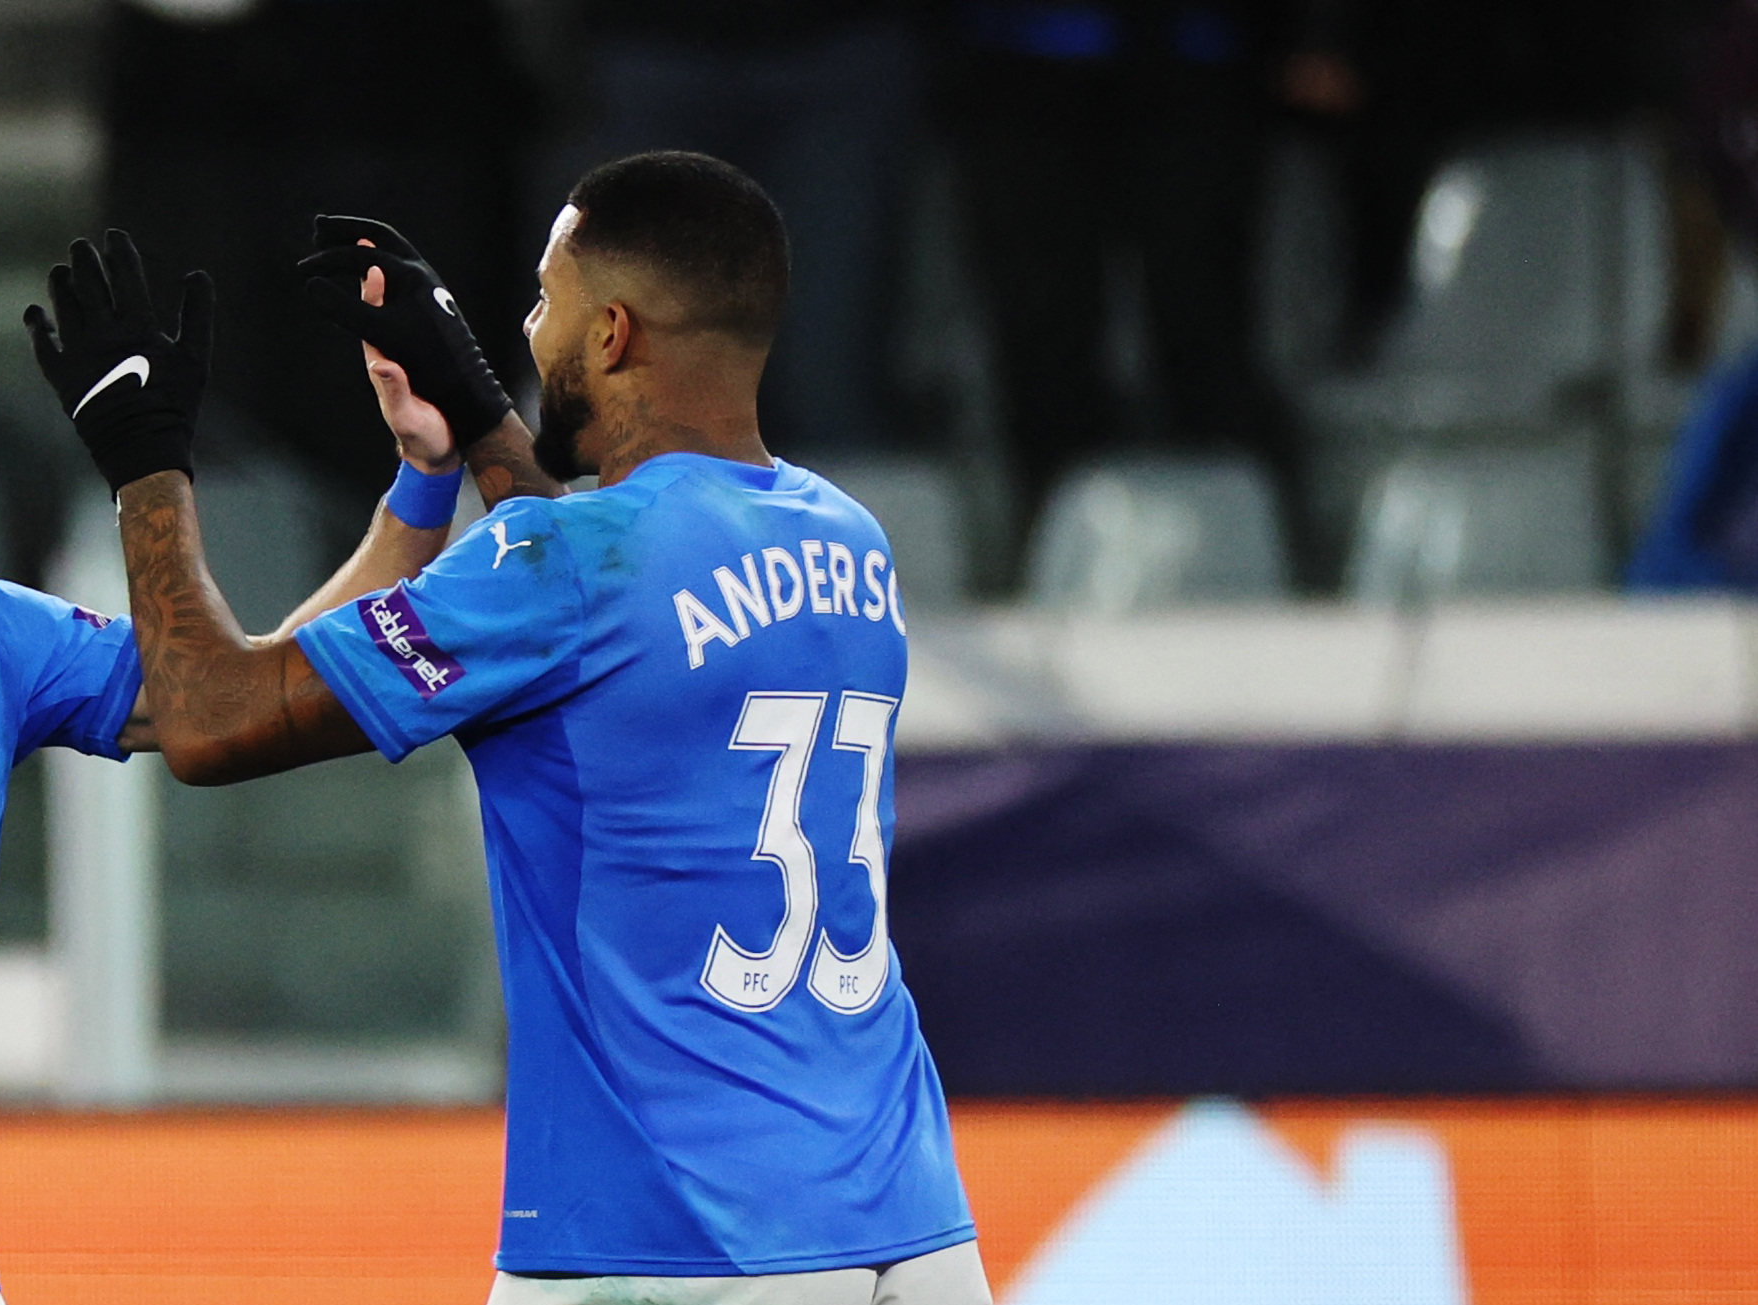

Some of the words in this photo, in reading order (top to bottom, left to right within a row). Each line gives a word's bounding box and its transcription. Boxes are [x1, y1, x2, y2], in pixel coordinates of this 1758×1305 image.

[370, 599, 450, 692] cablenet
[699, 690, 900, 1015] 33
[743, 972, 769, 992] PFC
[839, 975, 859, 994] PFC
